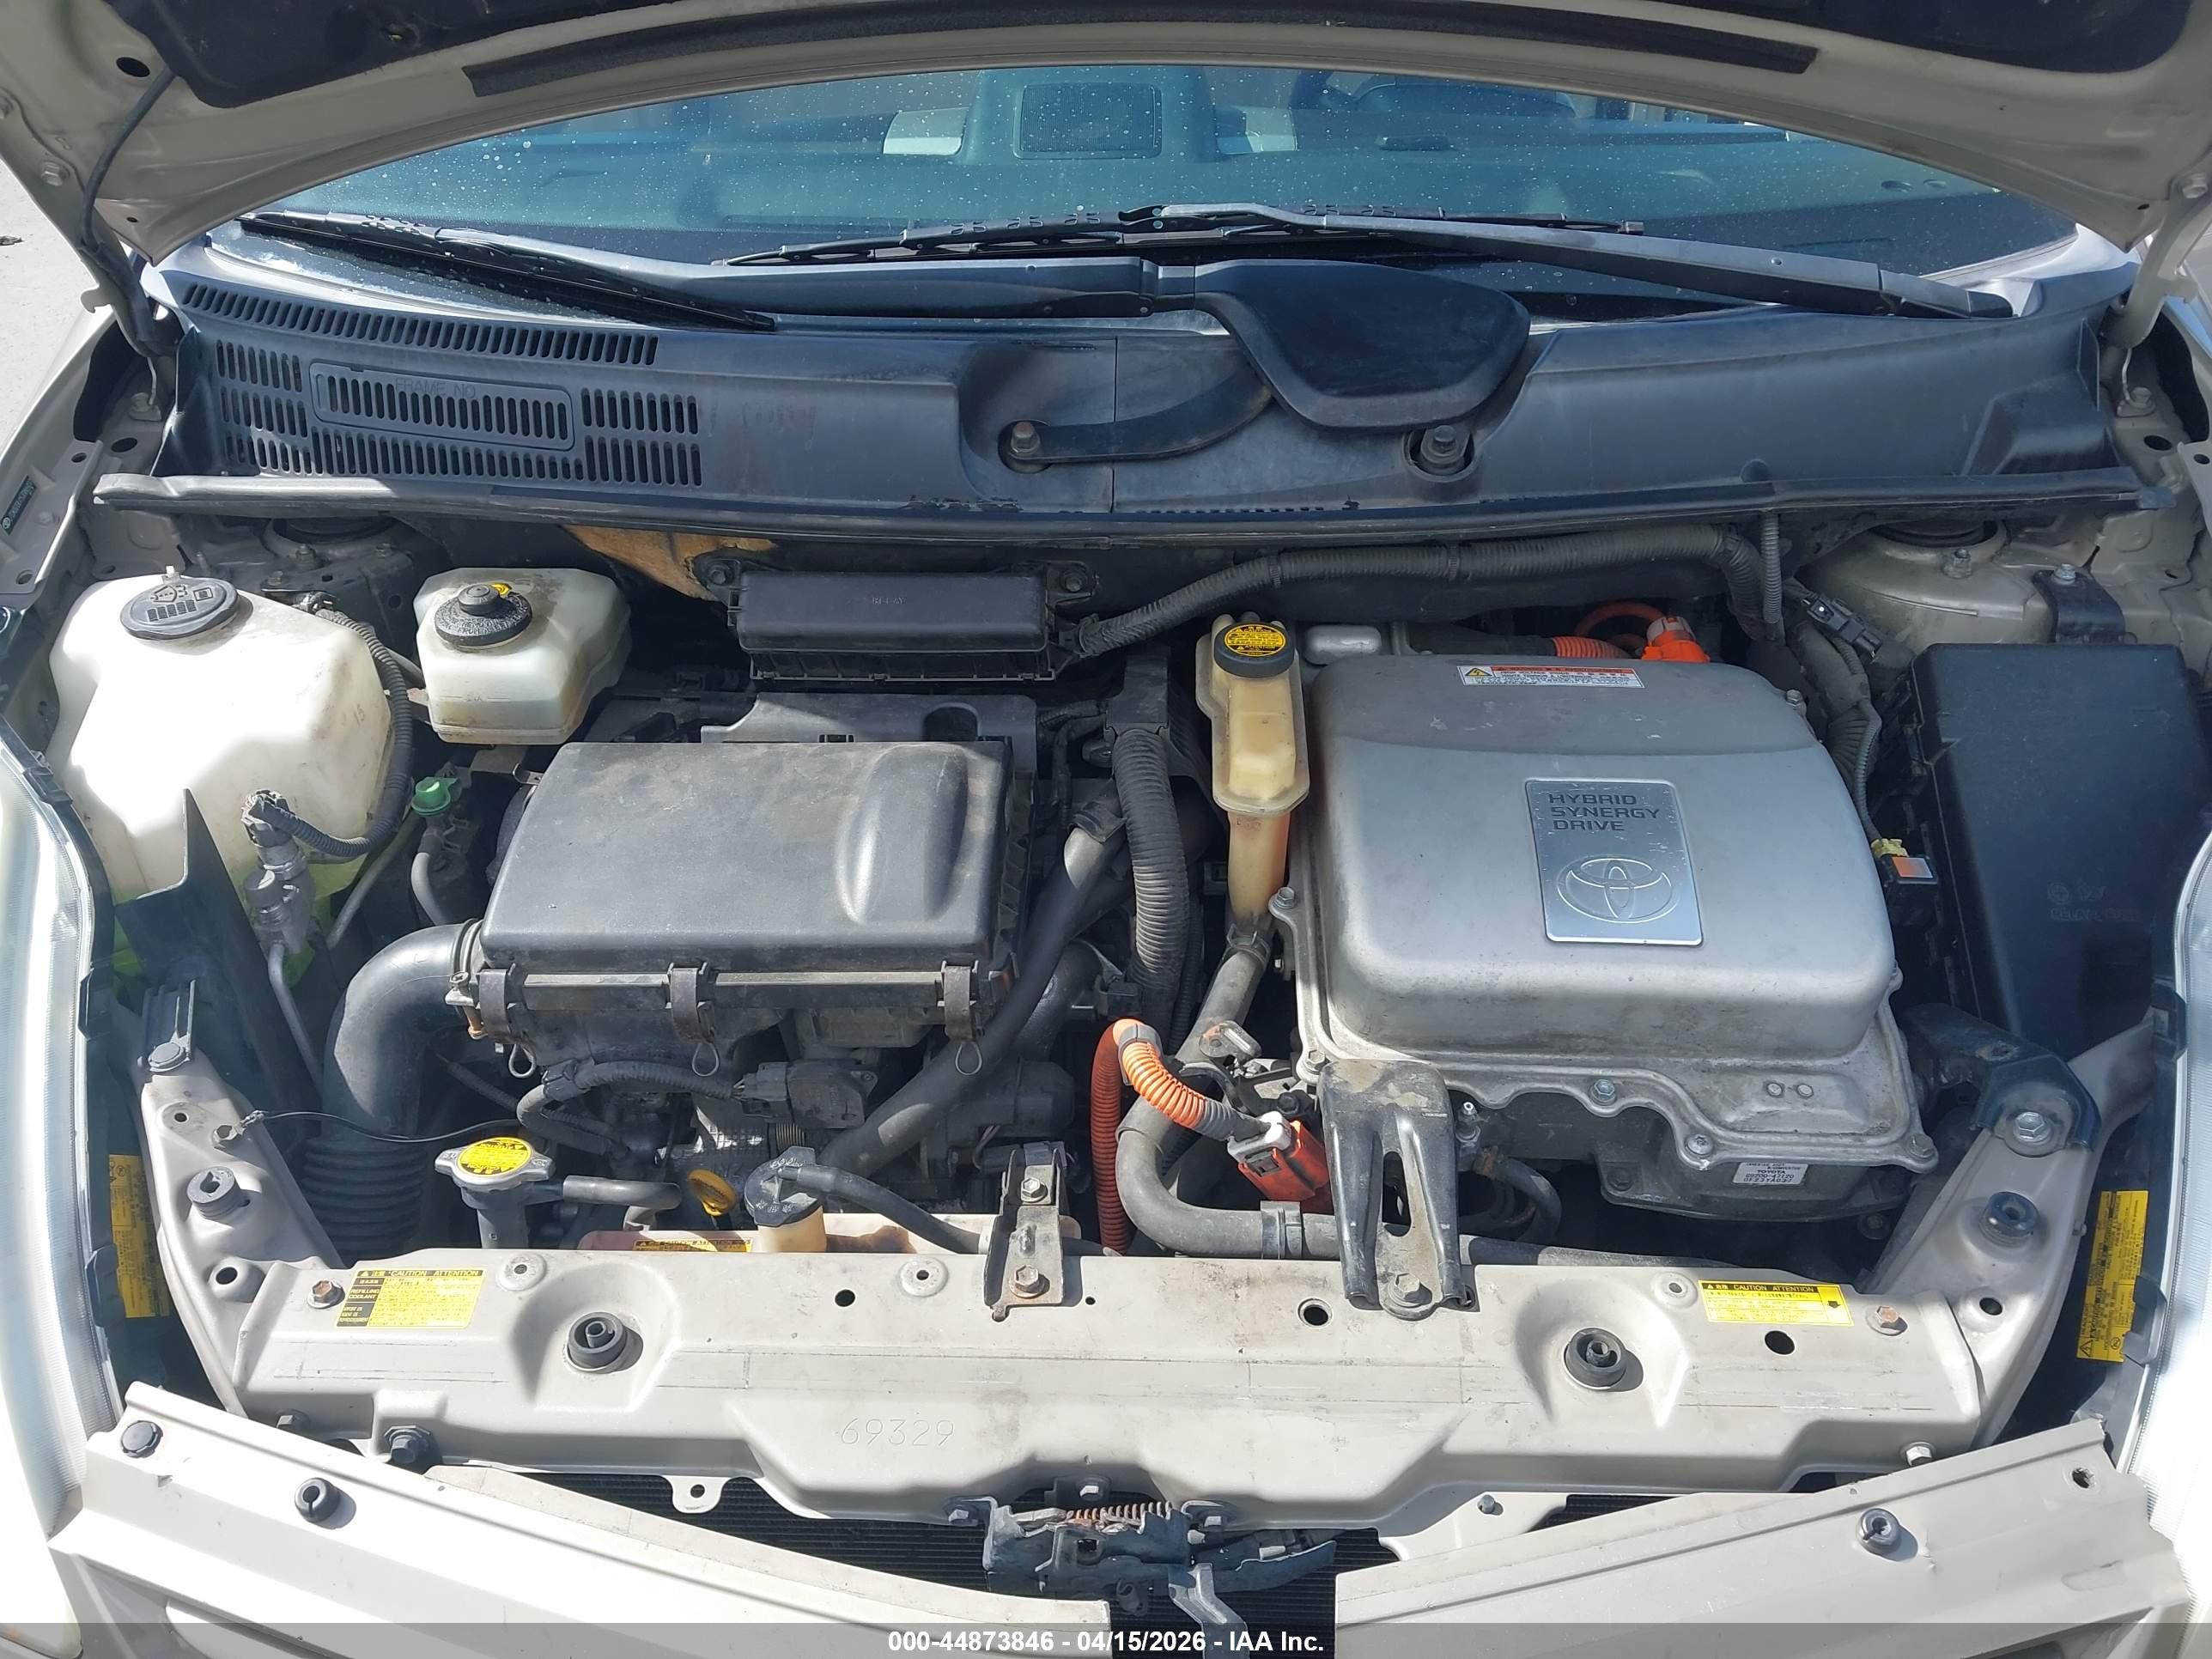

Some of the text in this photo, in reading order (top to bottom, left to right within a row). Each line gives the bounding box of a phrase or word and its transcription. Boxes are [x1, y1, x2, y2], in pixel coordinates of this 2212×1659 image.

[395, 377, 446, 396] FRAME
[1548, 793, 1637, 805] HYBRID
[1551, 806, 1660, 819] SYNERGY
[1553, 819, 1626, 831] DRIVE
[841, 1417, 954, 1447] 69329
